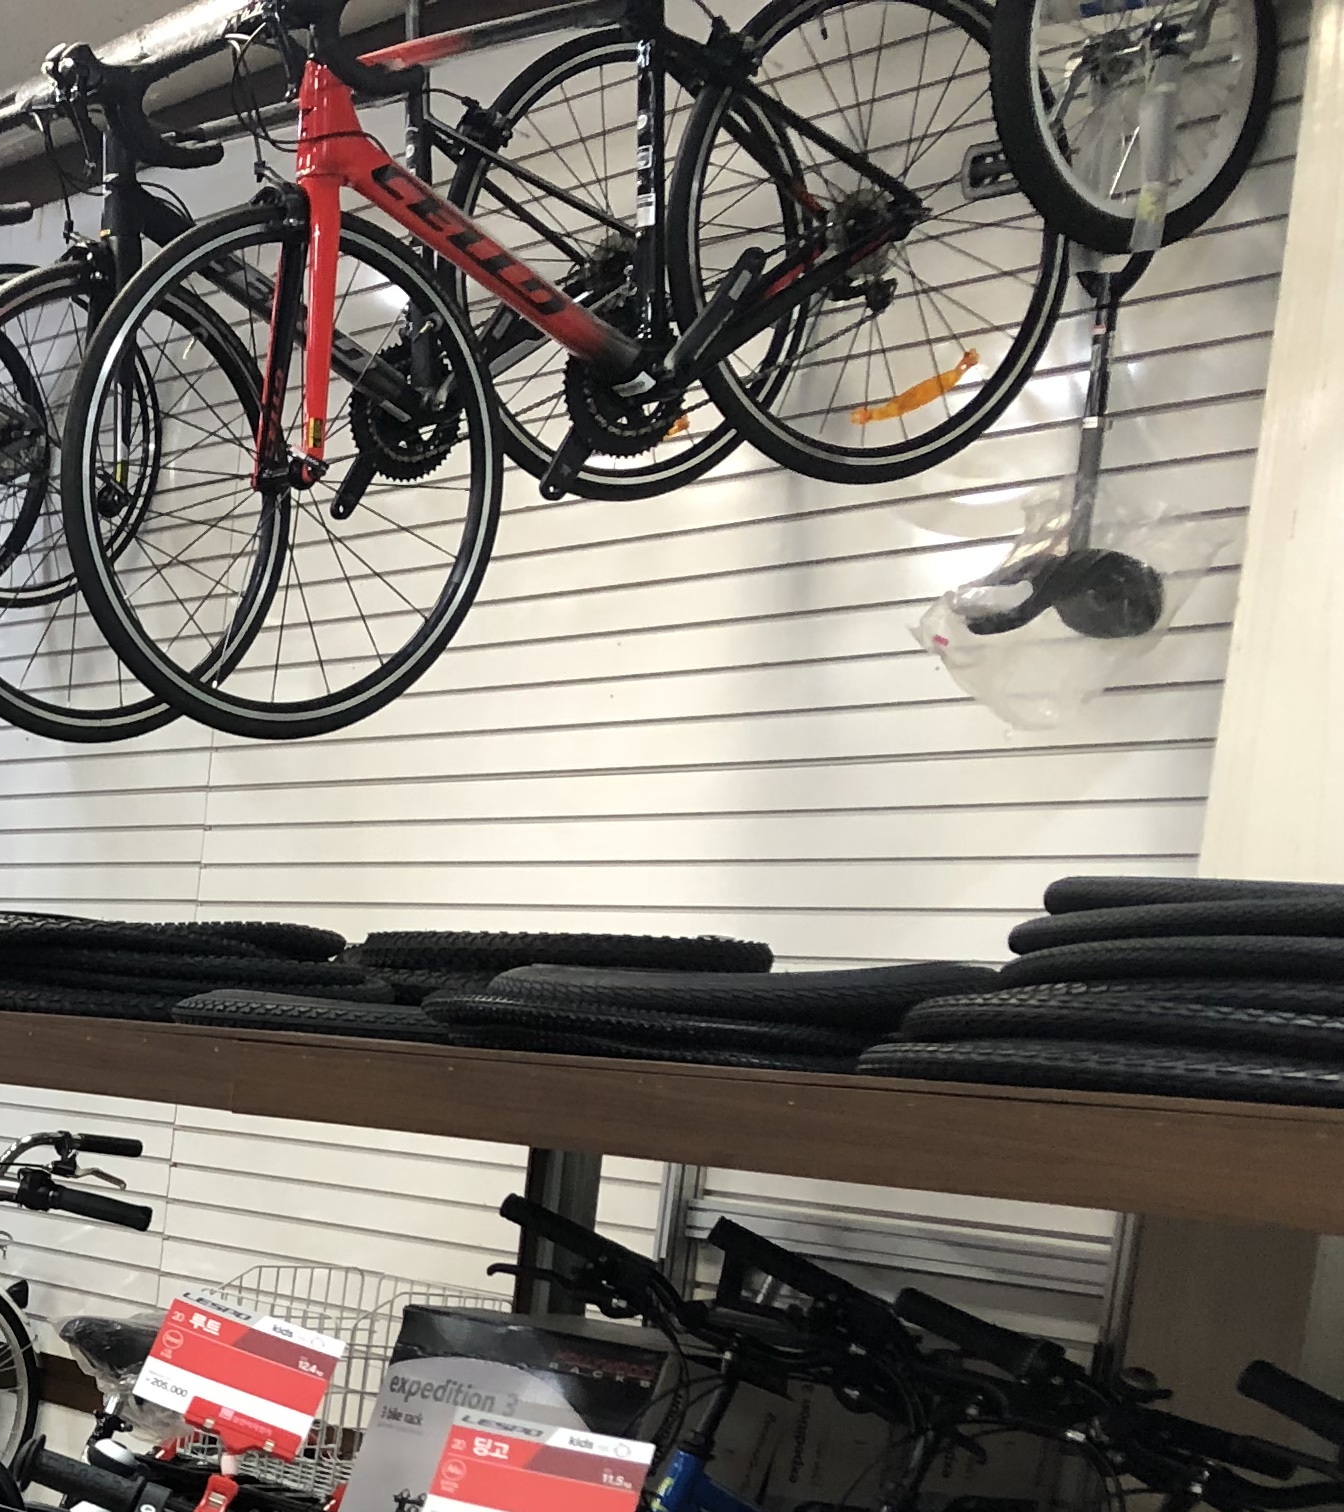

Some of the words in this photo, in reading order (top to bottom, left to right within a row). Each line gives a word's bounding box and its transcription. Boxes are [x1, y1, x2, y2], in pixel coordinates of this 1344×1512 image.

[172, 1311, 185, 1323] 20
[189, 1312, 221, 1336] 루트
[183, 1292, 252, 1321] LESPO
[272, 1324, 293, 1339] kids
[389, 1374, 496, 1412] expedition
[461, 1414, 544, 1438] LESPO
[568, 1435, 594, 1450] kids
[473, 1436, 509, 1460] 딩고
